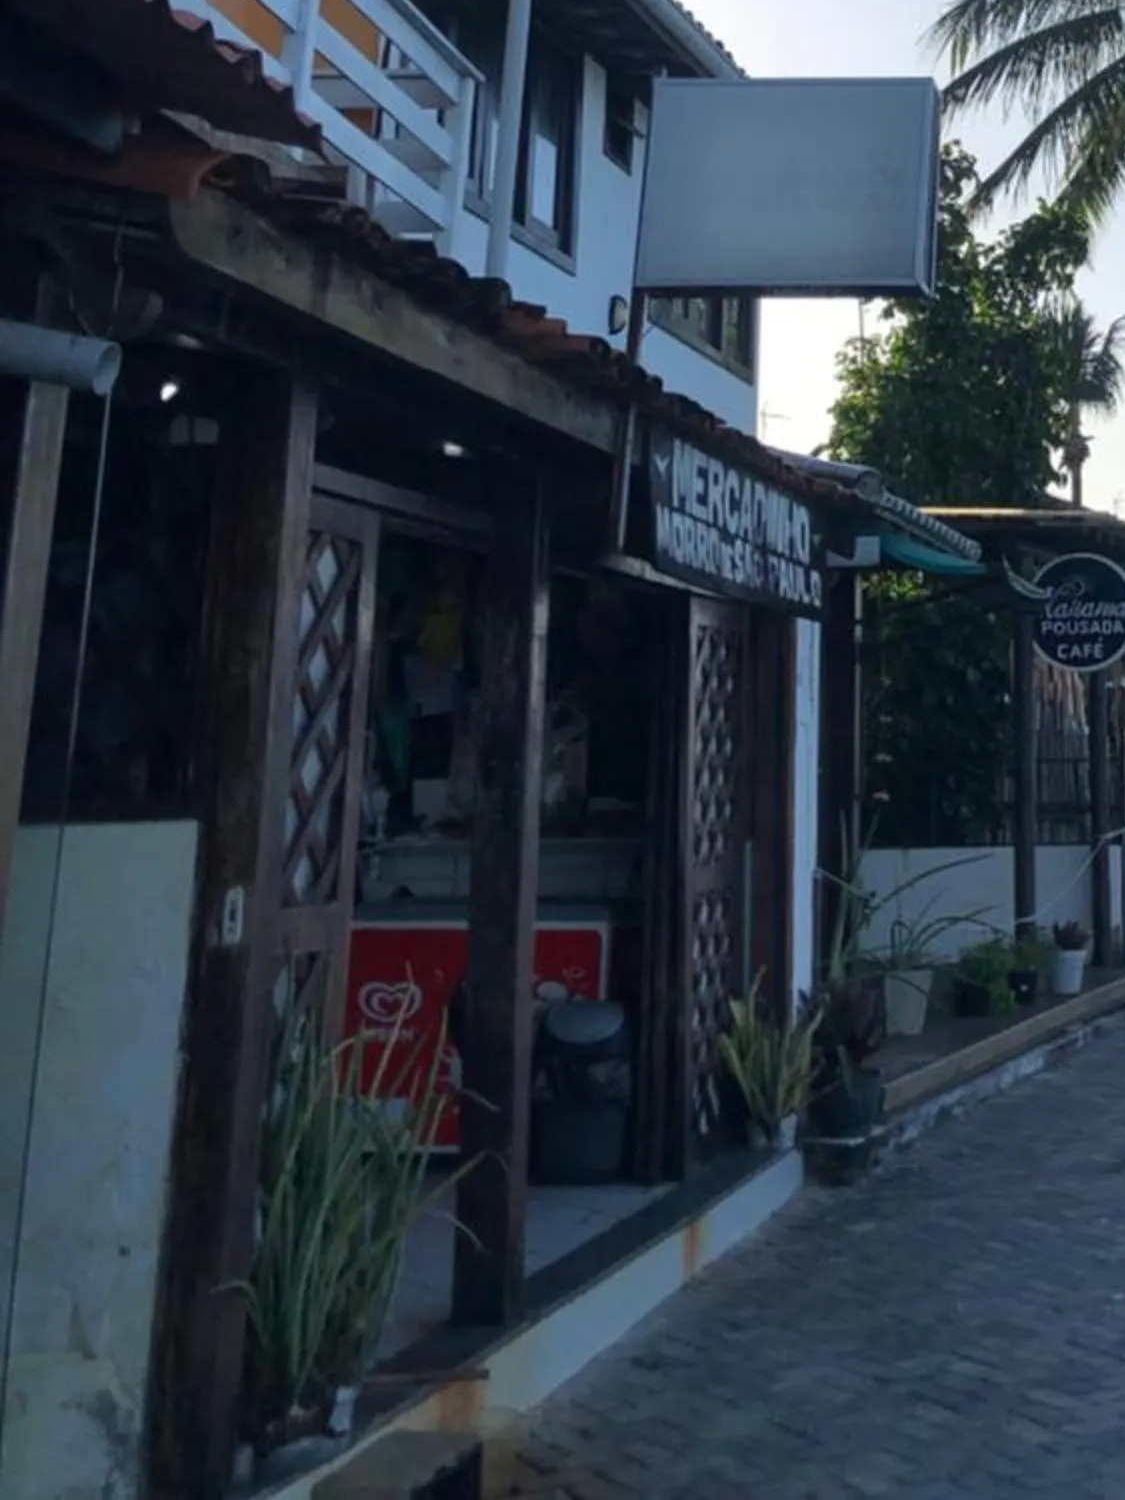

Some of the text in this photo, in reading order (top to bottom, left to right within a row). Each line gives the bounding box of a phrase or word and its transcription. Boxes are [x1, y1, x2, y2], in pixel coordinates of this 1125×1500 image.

[672, 438, 810, 565] MERCADINHO
[656, 501, 718, 574] MORRO
[767, 553, 822, 608] PAULO
[1041, 620, 1125, 635] POUSADA
[1057, 636, 1104, 660] CAFÉ
